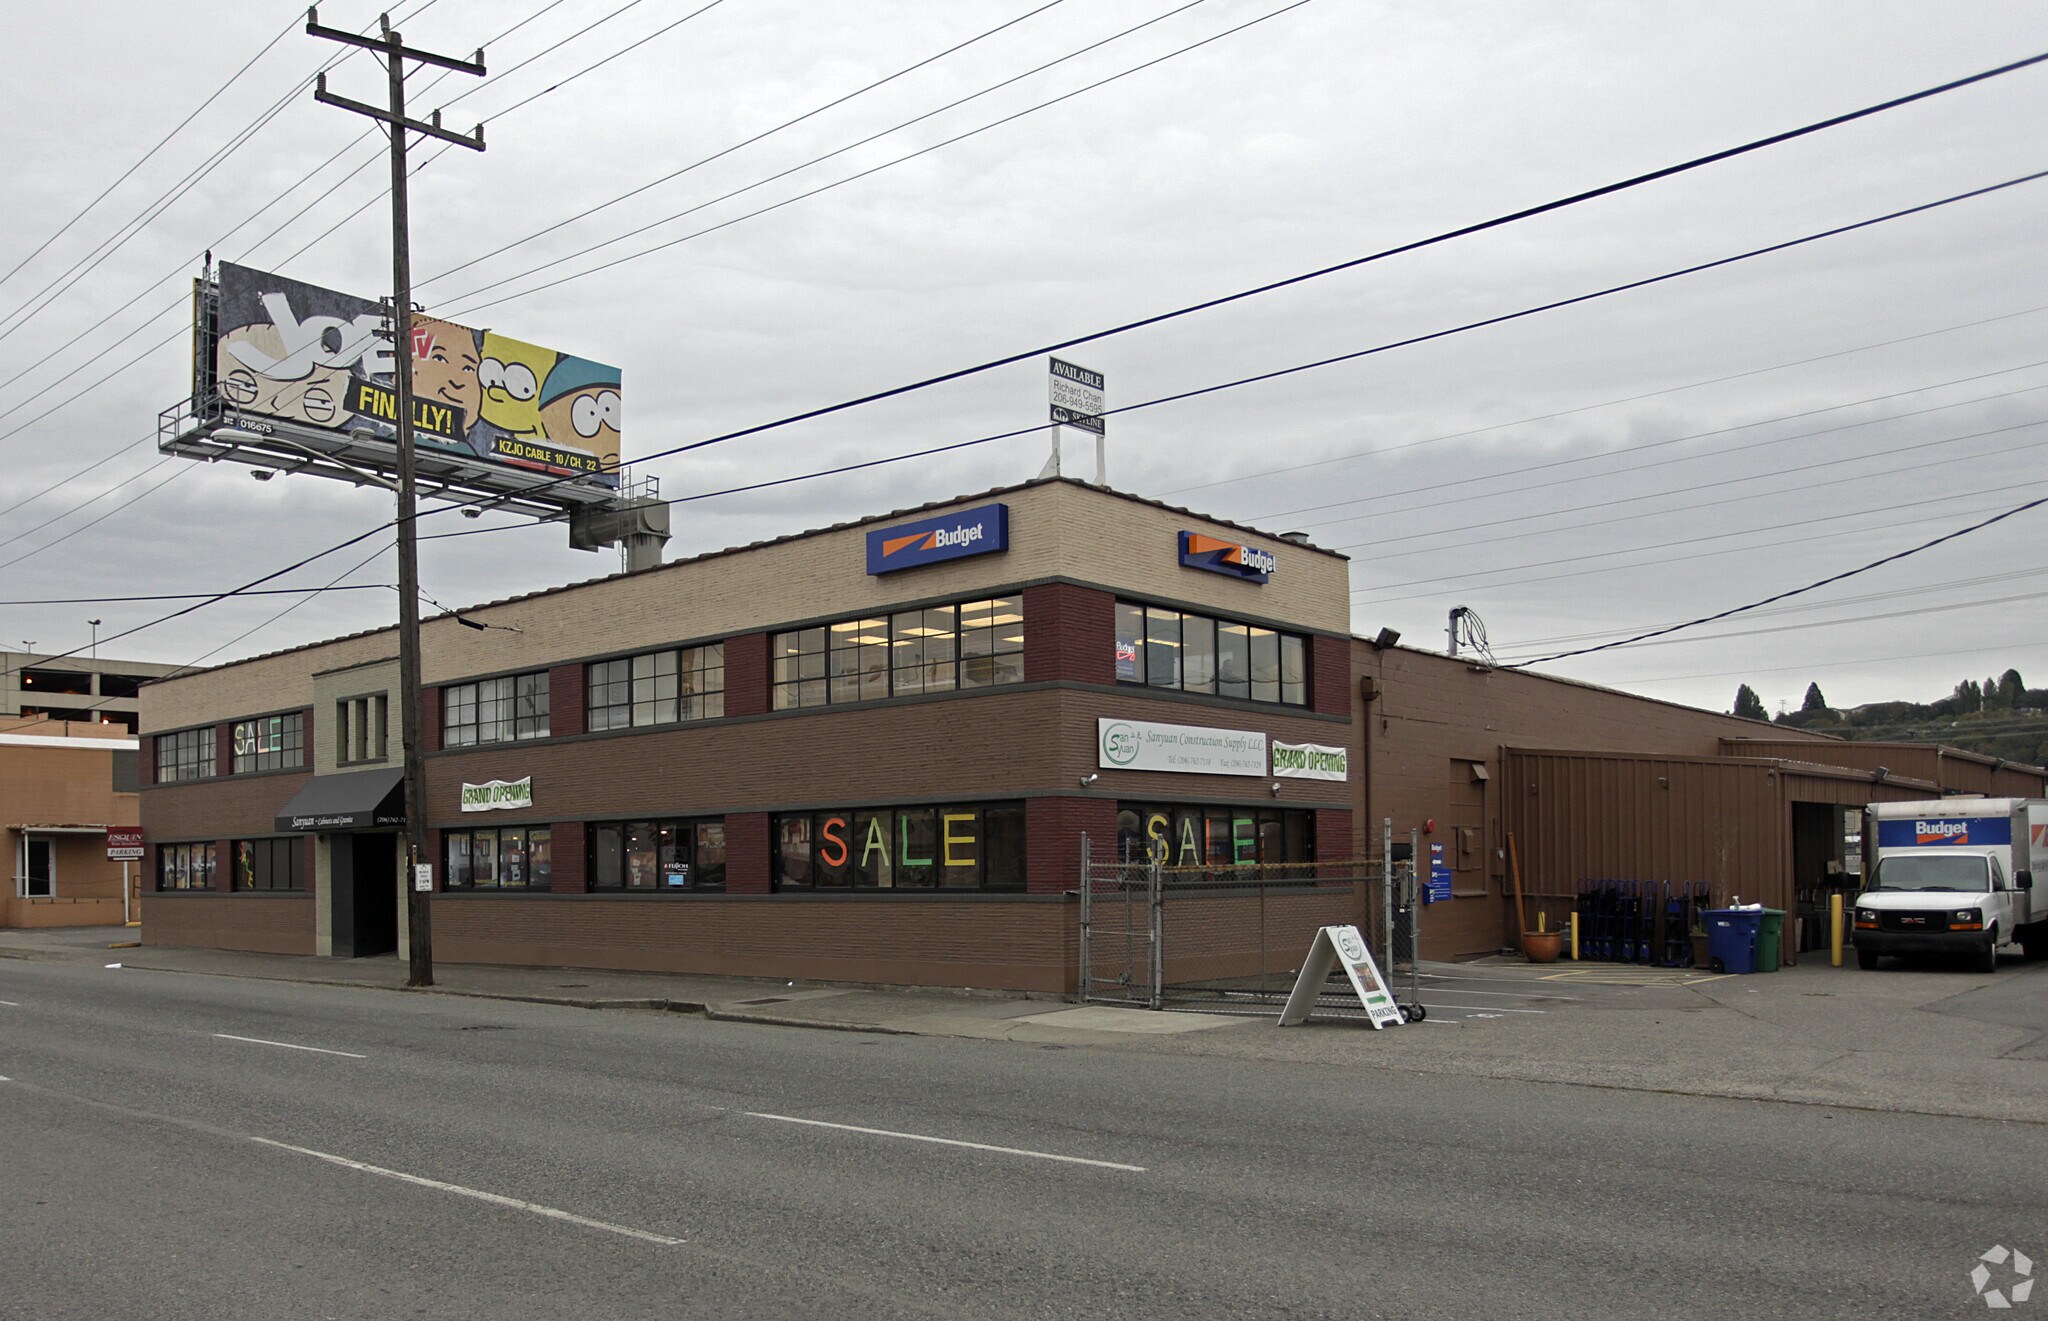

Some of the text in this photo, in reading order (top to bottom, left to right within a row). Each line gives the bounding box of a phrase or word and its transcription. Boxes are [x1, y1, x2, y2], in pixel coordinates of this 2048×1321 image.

[1053, 362, 1102, 387] AVAILABLE
[1053, 380, 1102, 403] Richard Chan
[1053, 391, 1103, 414] 206-949-5595
[359, 386, 452, 434] FINLLY!
[240, 419, 272, 433] 016675
[499, 440, 524, 456] KZJO
[525, 446, 551, 461] CABLE
[586, 460, 596, 471] 22
[935, 523, 982, 547] Budget
[1241, 546, 1276, 574] Budget
[234, 719, 281, 755] SALE
[1146, 730, 1178, 746] Sanyuan
[1180, 733, 1223, 747] Construction
[1224, 736, 1247, 752] Supply
[1273, 748, 1345, 773] GRAND OPENING
[463, 783, 530, 804] GRAND OPENING
[821, 813, 976, 867] SALE
[1146, 815, 1256, 867] SALE
[1915, 821, 1968, 837] Budget
[1370, 1006, 1398, 1019] PARKING
